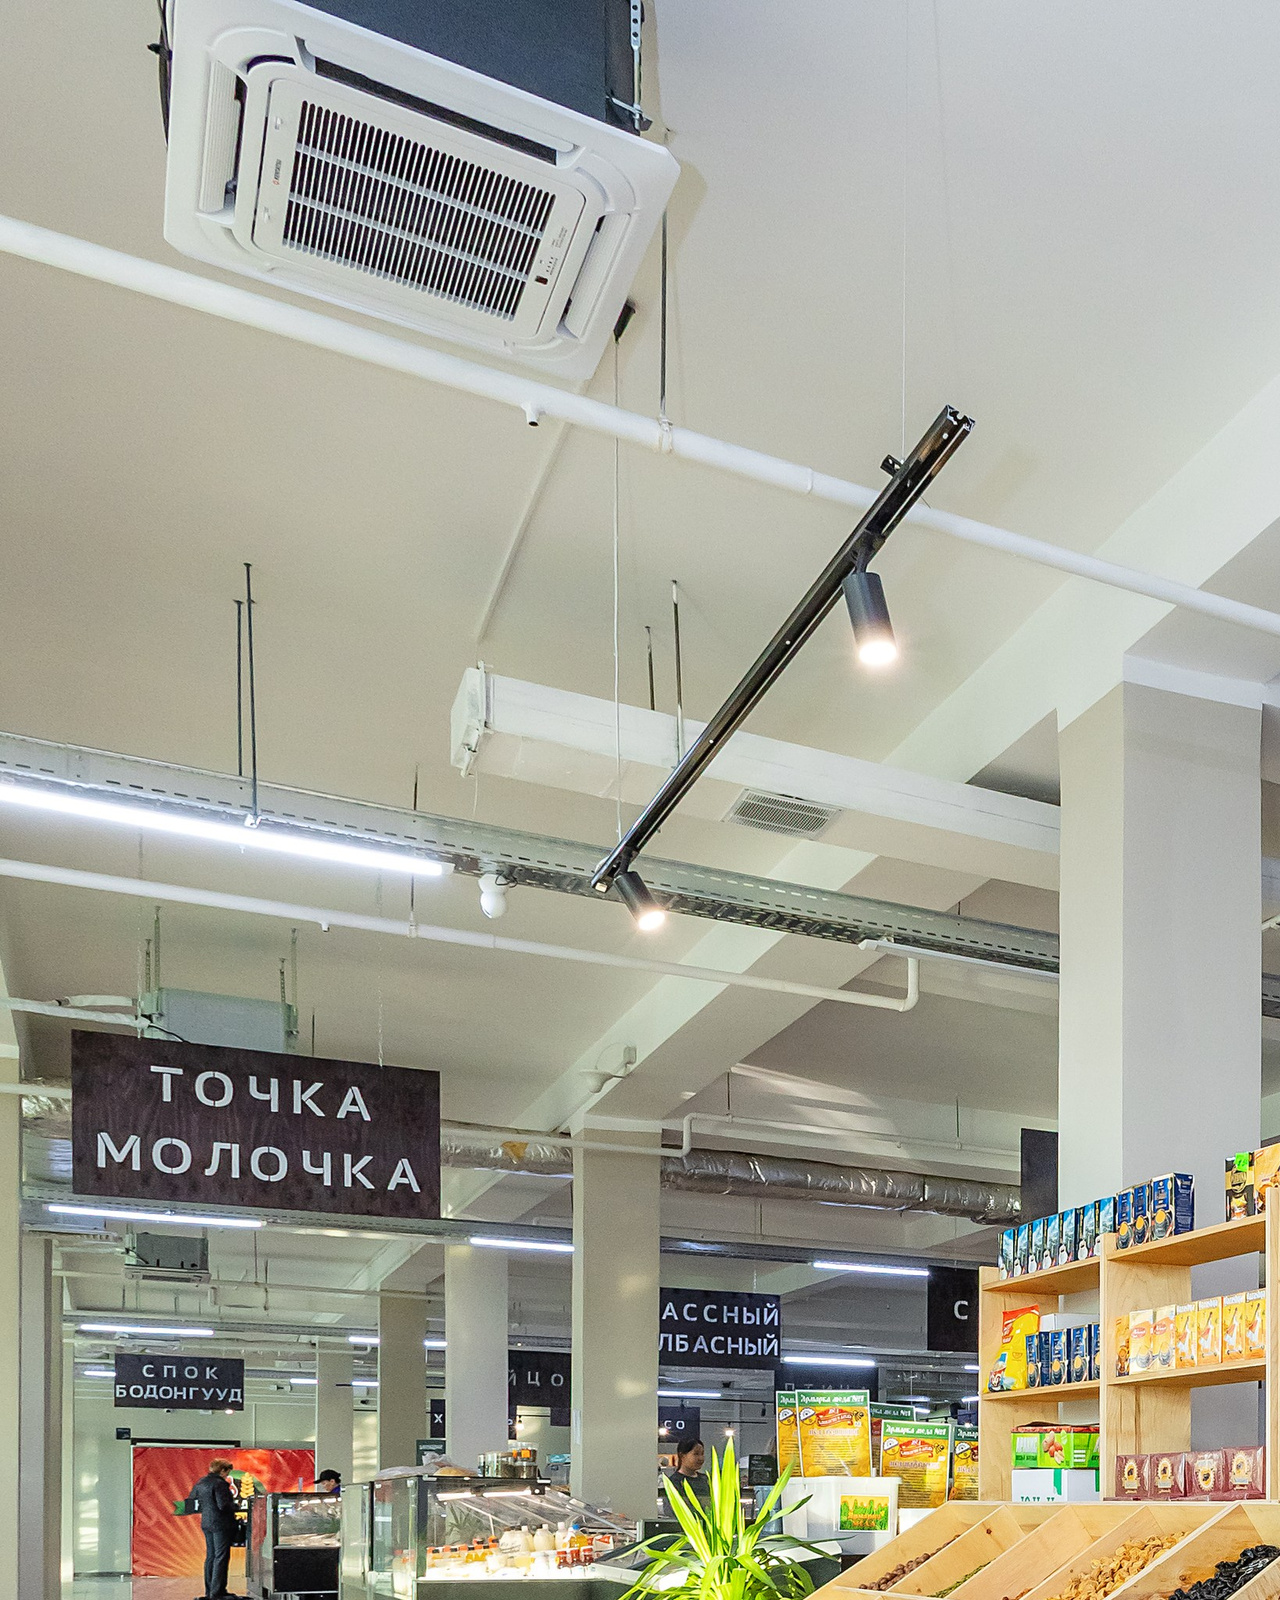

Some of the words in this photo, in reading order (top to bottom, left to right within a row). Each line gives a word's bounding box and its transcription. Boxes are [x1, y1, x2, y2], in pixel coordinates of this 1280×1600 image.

[150, 1065, 371, 1122] ТОЧКА
[97, 1131, 421, 1193] МОЛОЧКА
[662, 1301, 779, 1326] АССНЫЙ
[953, 1300, 969, 1321] С
[658, 1332, 779, 1357] ЛБАСНЫЙ
[142, 1364, 219, 1380] СПОК
[508, 1370, 564, 1387] ЙЦО
[115, 1384, 243, 1403] БОДОНГУУД
[664, 1419, 686, 1430] СО
